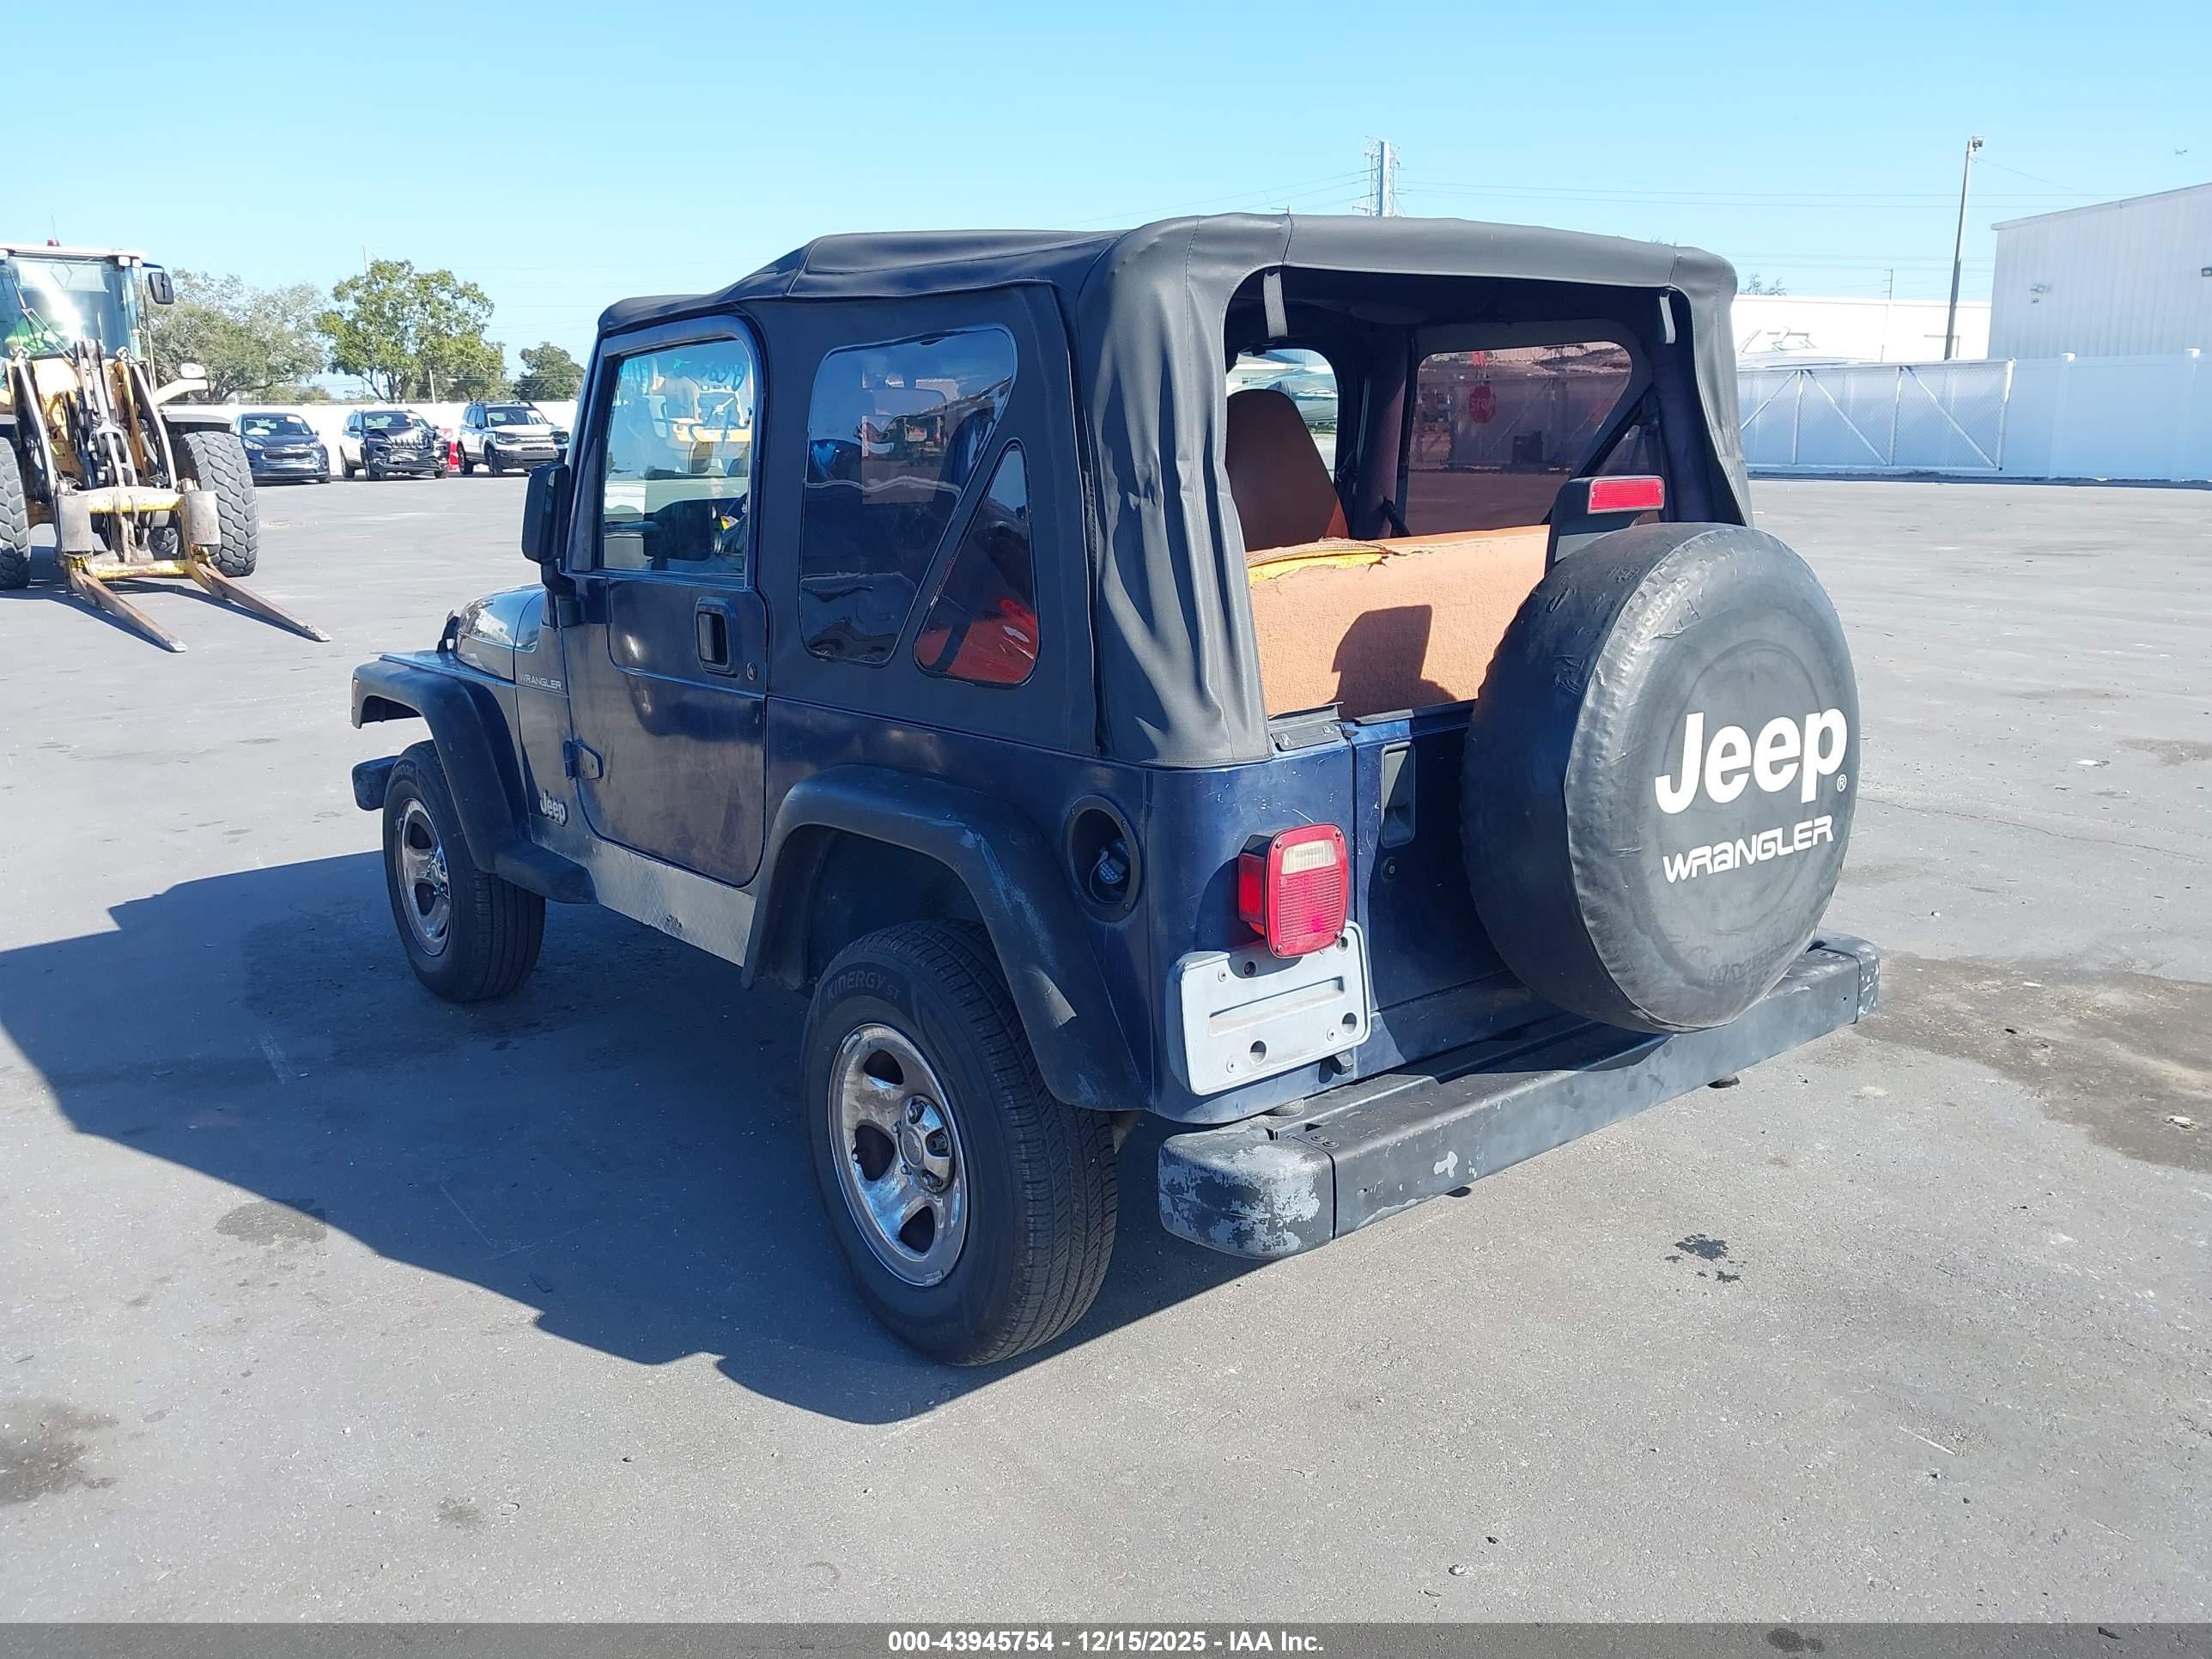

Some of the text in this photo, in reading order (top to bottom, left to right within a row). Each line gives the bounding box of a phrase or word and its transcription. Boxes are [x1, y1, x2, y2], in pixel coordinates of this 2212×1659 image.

[517, 672, 562, 690] WRANGLER
[539, 788, 567, 826] Jeep
[827, 970, 901, 1002] KINERGY ST
